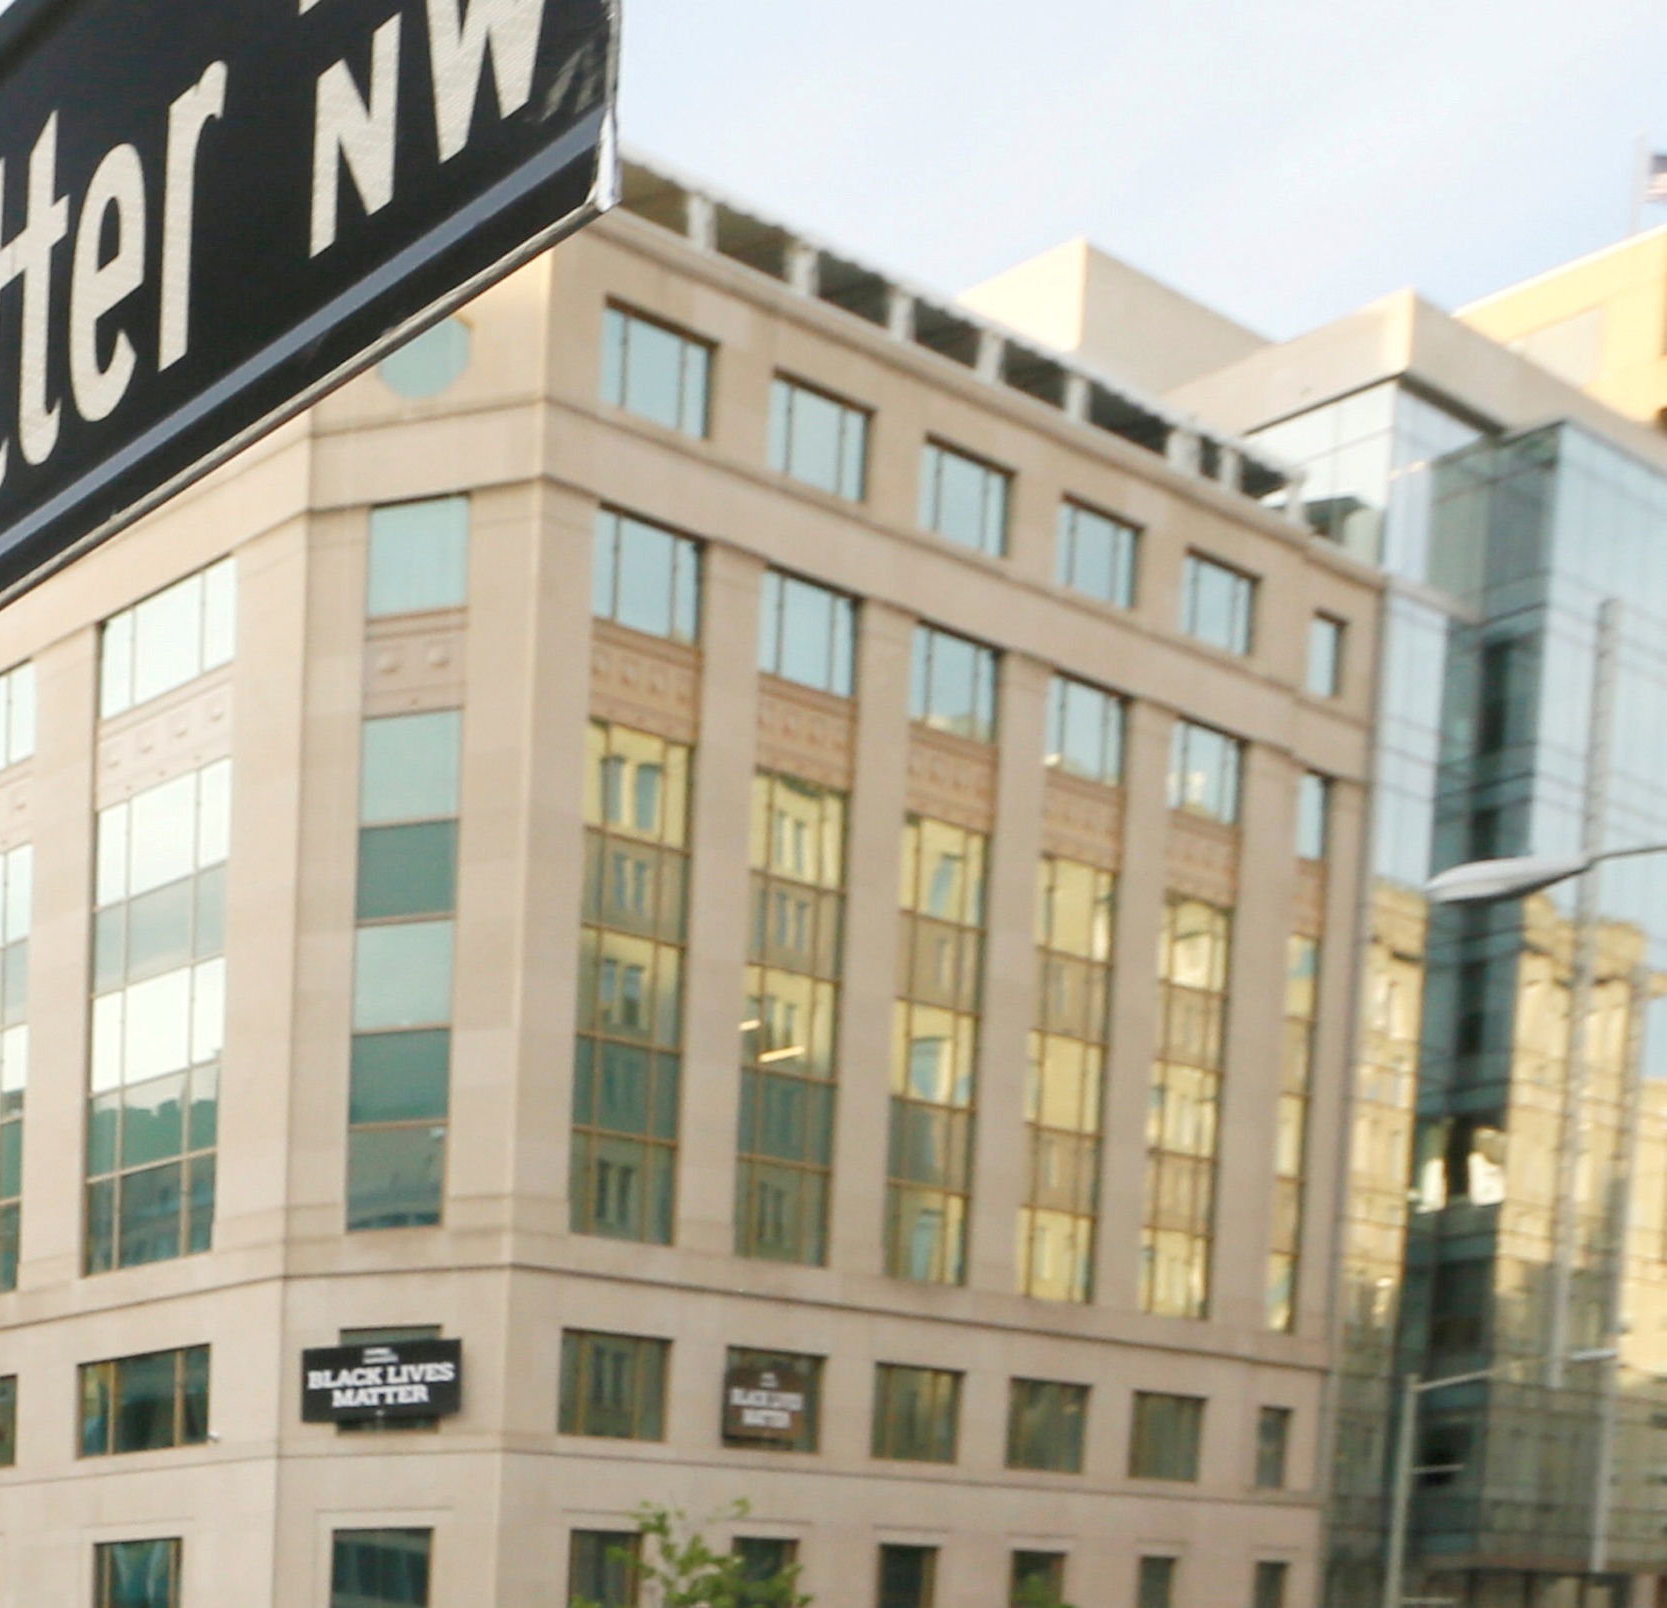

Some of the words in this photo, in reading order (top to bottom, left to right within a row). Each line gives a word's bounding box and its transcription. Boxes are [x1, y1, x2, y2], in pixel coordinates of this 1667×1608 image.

[309, 0, 544, 260] NW
[307, 1366, 383, 1389] BLACK
[387, 1362, 455, 1385] LIVES
[332, 1384, 429, 1407] MATTER
